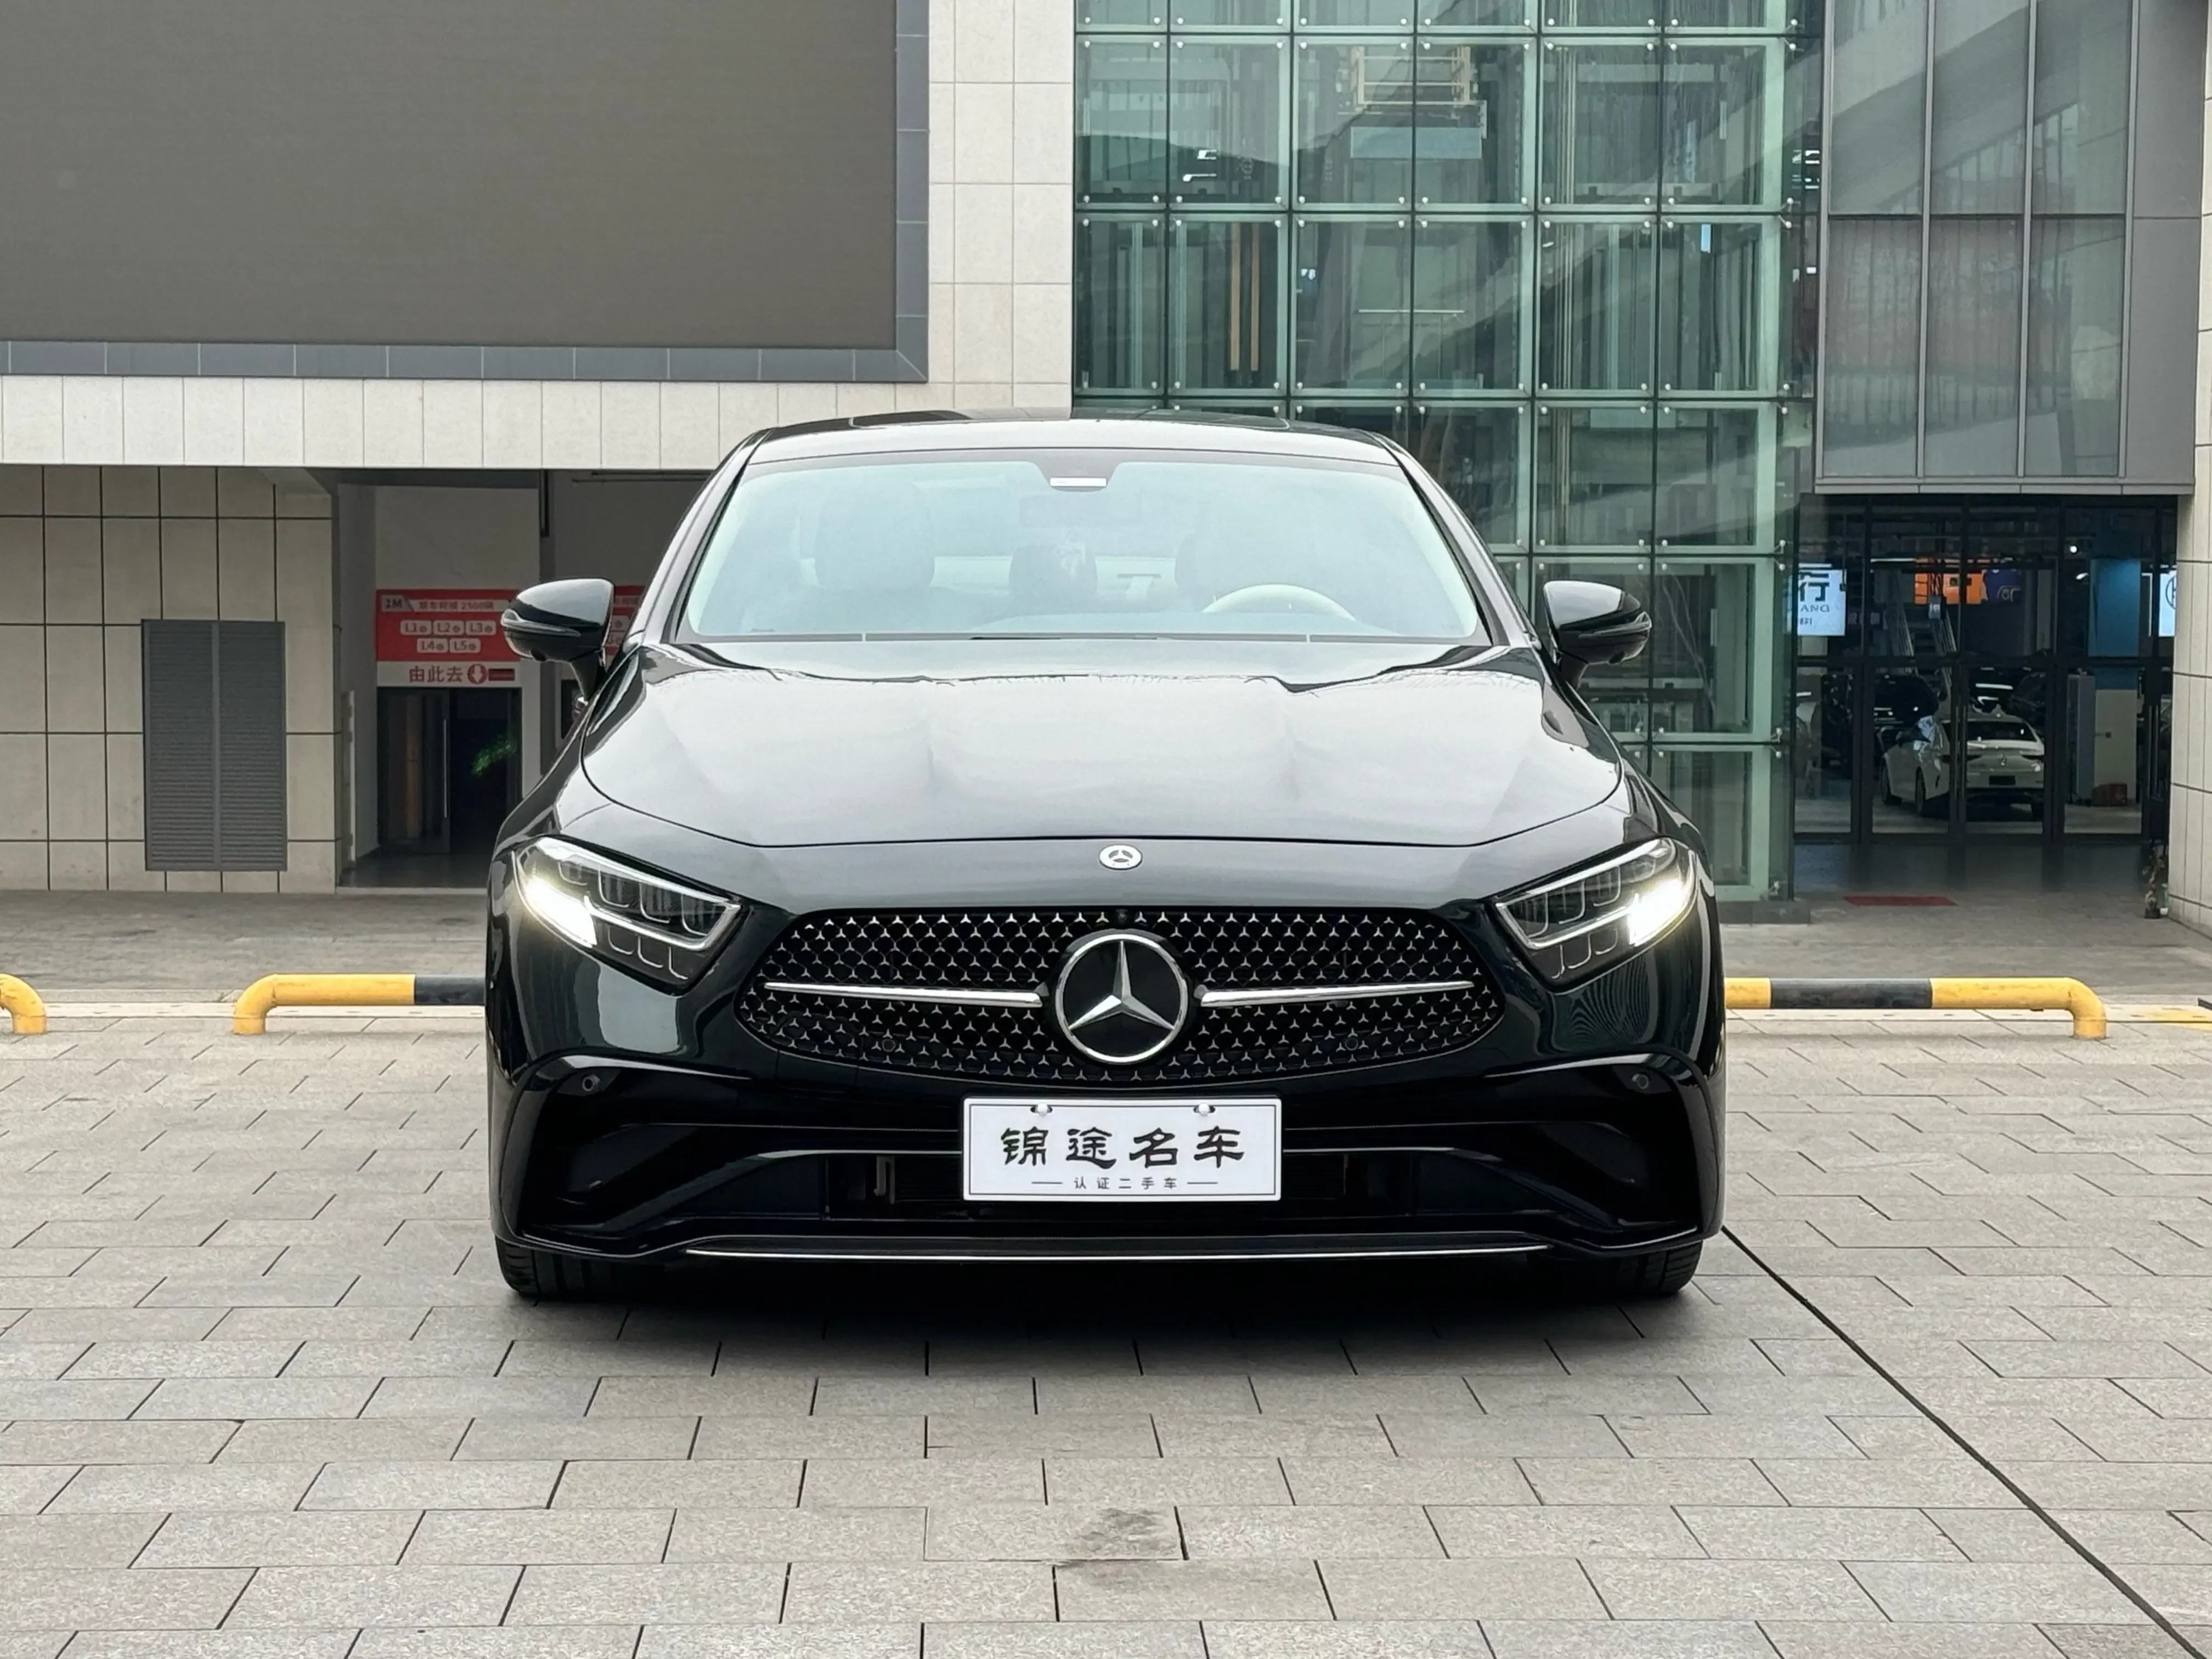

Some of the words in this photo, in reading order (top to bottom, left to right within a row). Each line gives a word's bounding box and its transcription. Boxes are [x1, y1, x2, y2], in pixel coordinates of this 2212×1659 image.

[409, 665, 463, 682] 由此去
[1001, 1126, 1245, 1169] 锦途名车
[1074, 1177, 1178, 1190] 认证二手车
